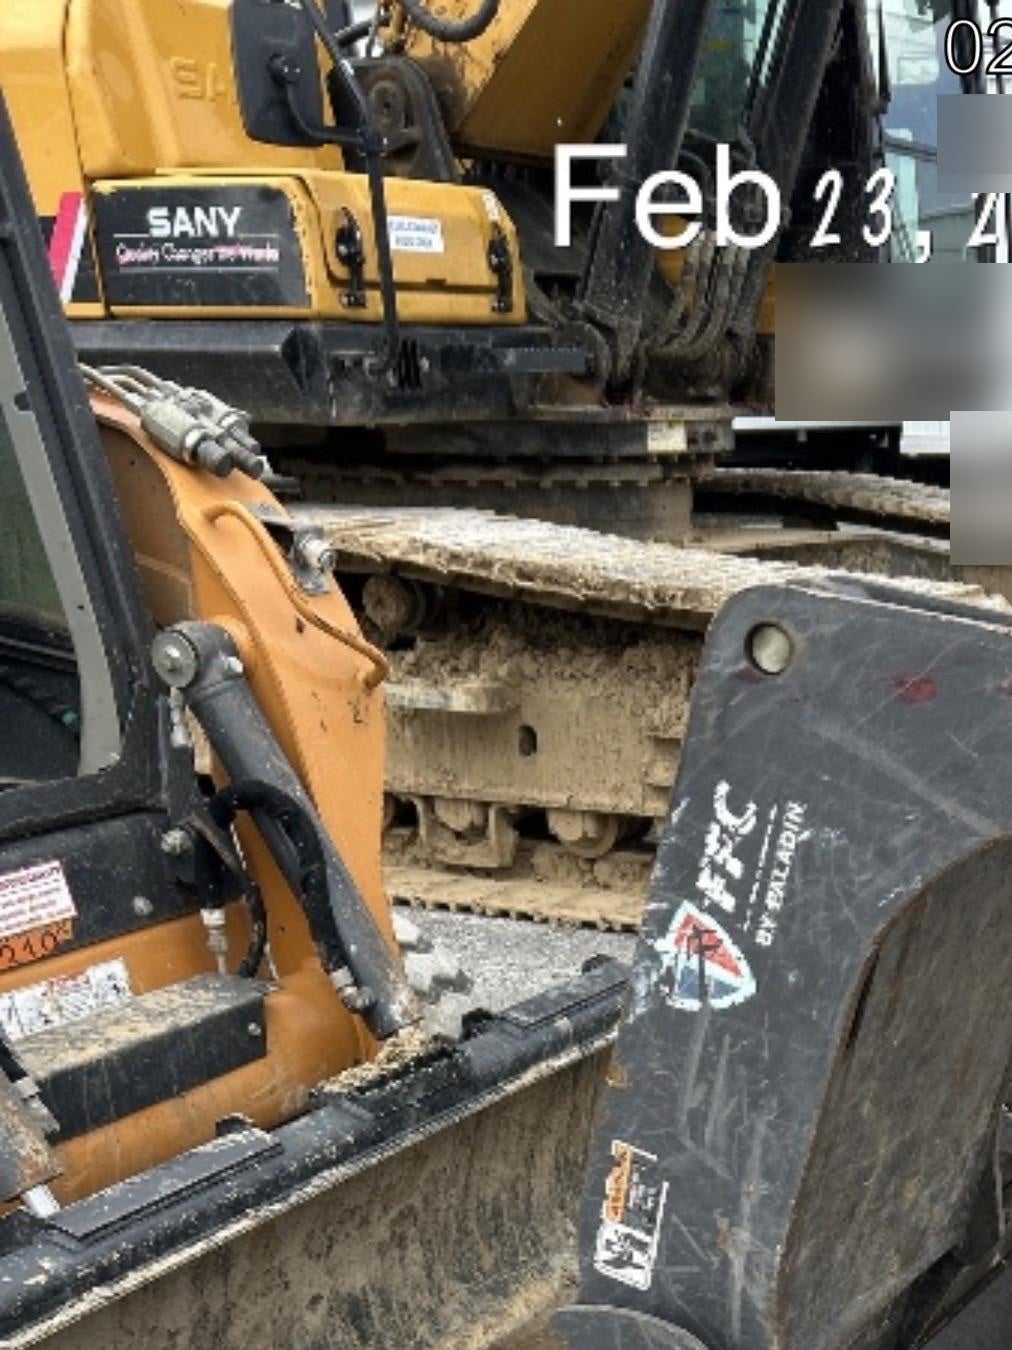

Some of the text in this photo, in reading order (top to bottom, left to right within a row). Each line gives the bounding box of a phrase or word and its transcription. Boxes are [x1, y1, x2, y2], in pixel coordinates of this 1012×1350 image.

[147, 206, 242, 238] SANY
[697, 779, 757, 913] FFC
[755, 801, 807, 947] BY PALADIN
